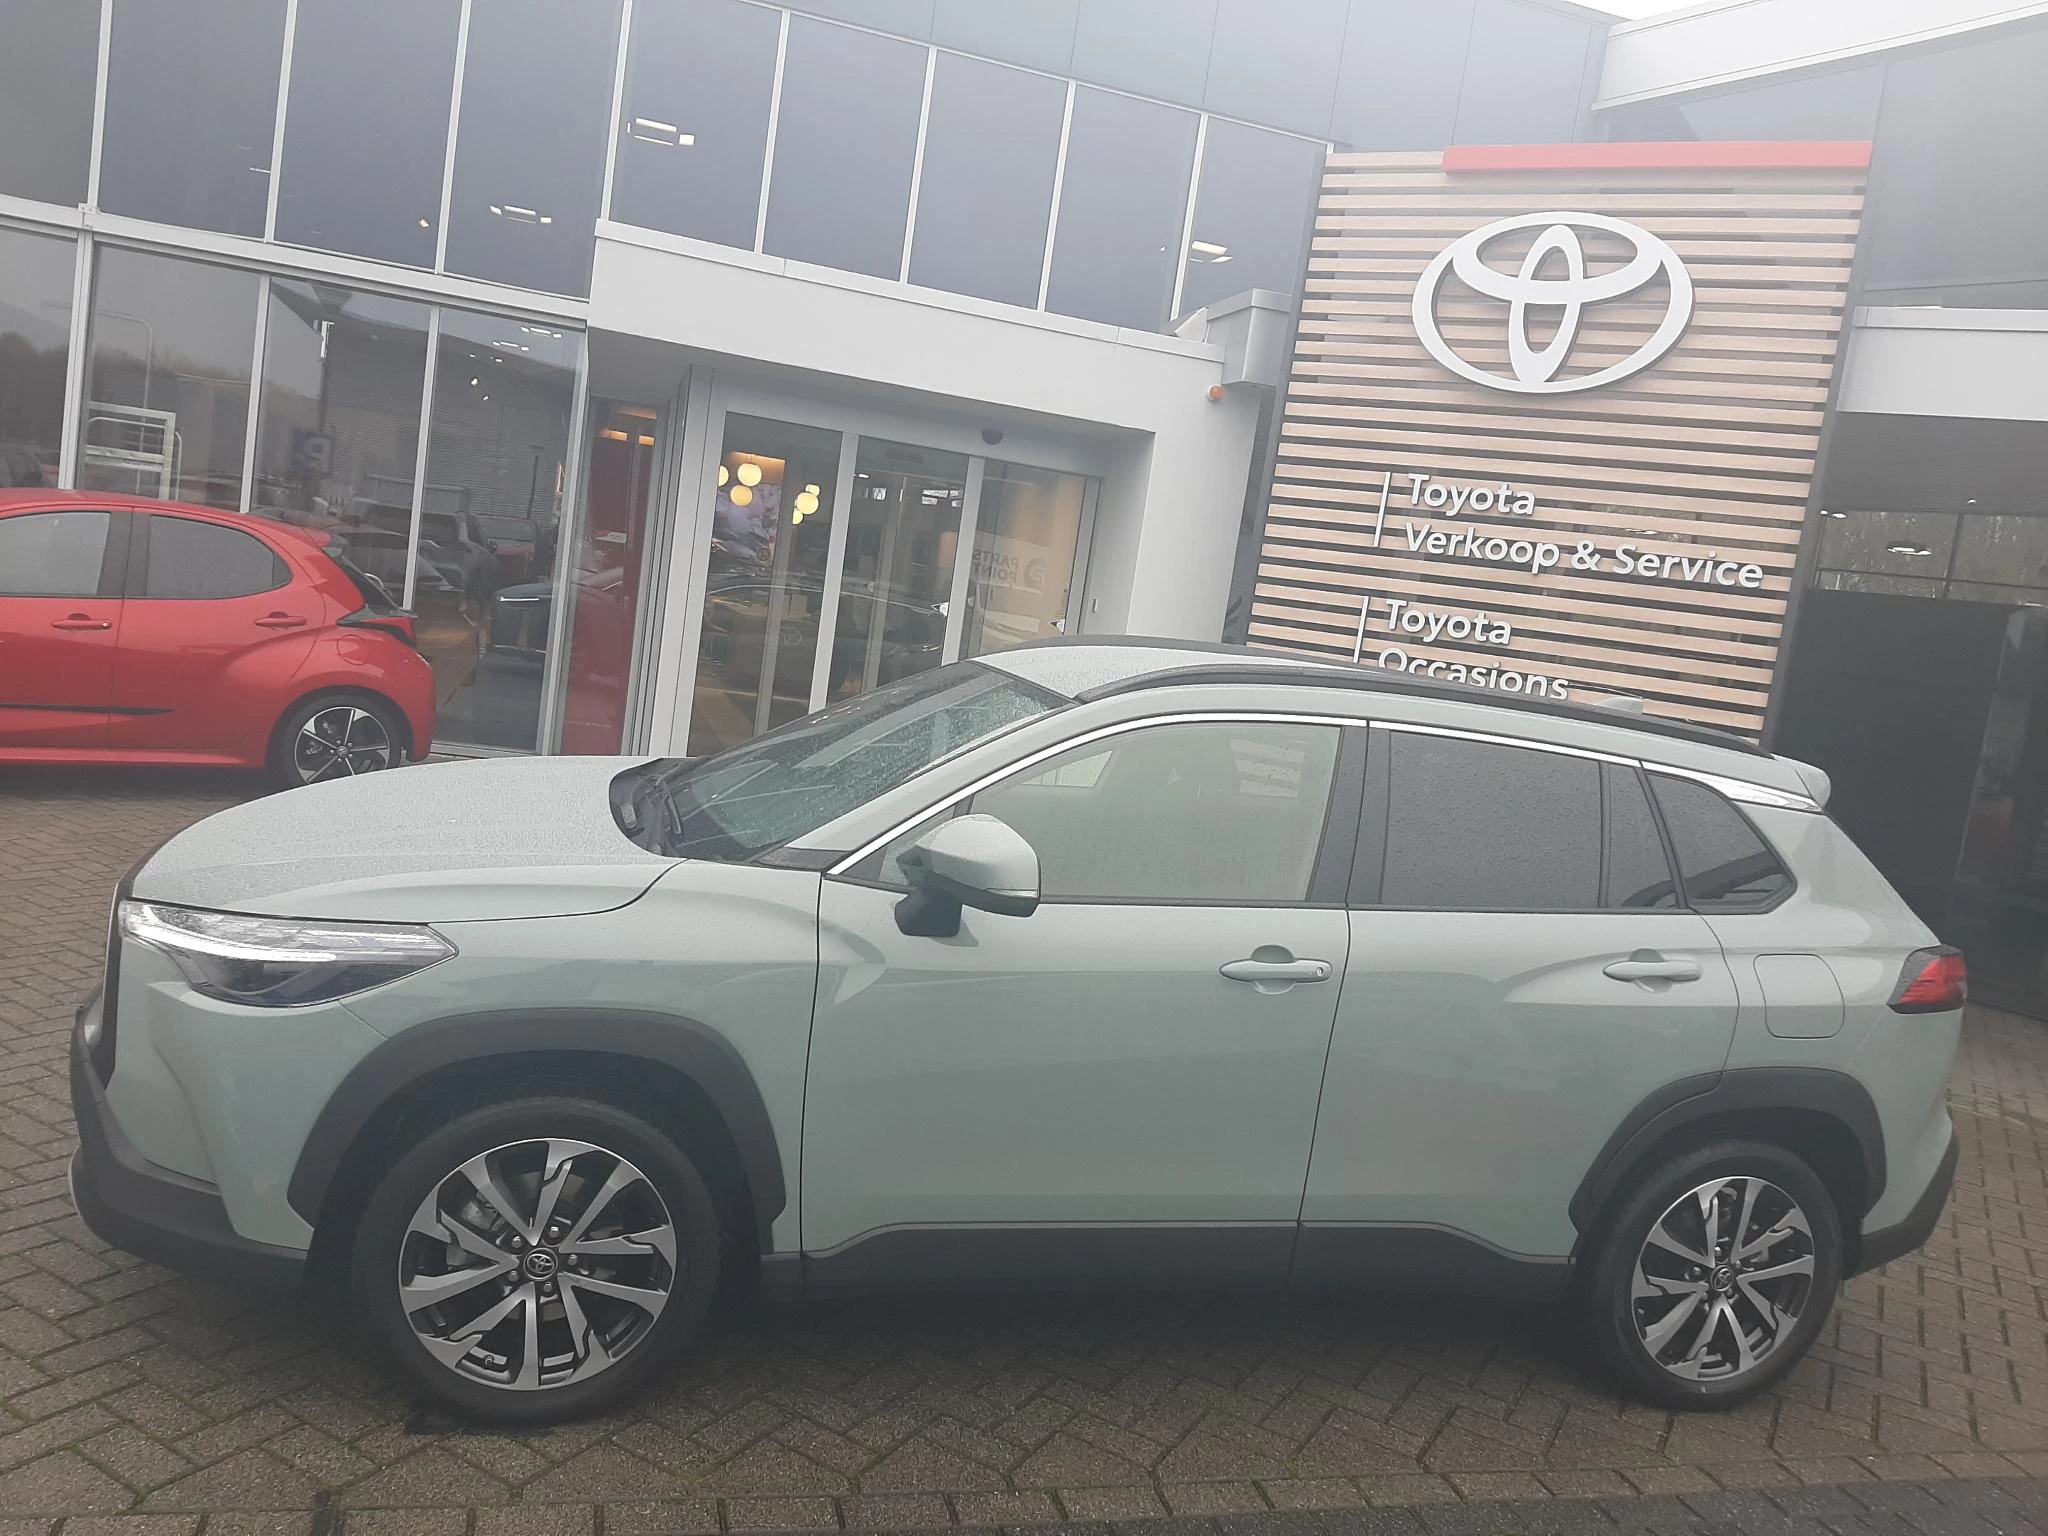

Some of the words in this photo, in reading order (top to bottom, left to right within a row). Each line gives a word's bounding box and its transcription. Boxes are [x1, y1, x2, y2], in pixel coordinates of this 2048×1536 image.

[1408, 473, 1535, 516] Toyota
[1405, 522, 1560, 574] Verkoop
[1570, 539, 1601, 571] &
[1612, 543, 1763, 588] Service
[1386, 599, 1511, 645] Toyota
[1378, 647, 1569, 700] Occasions
